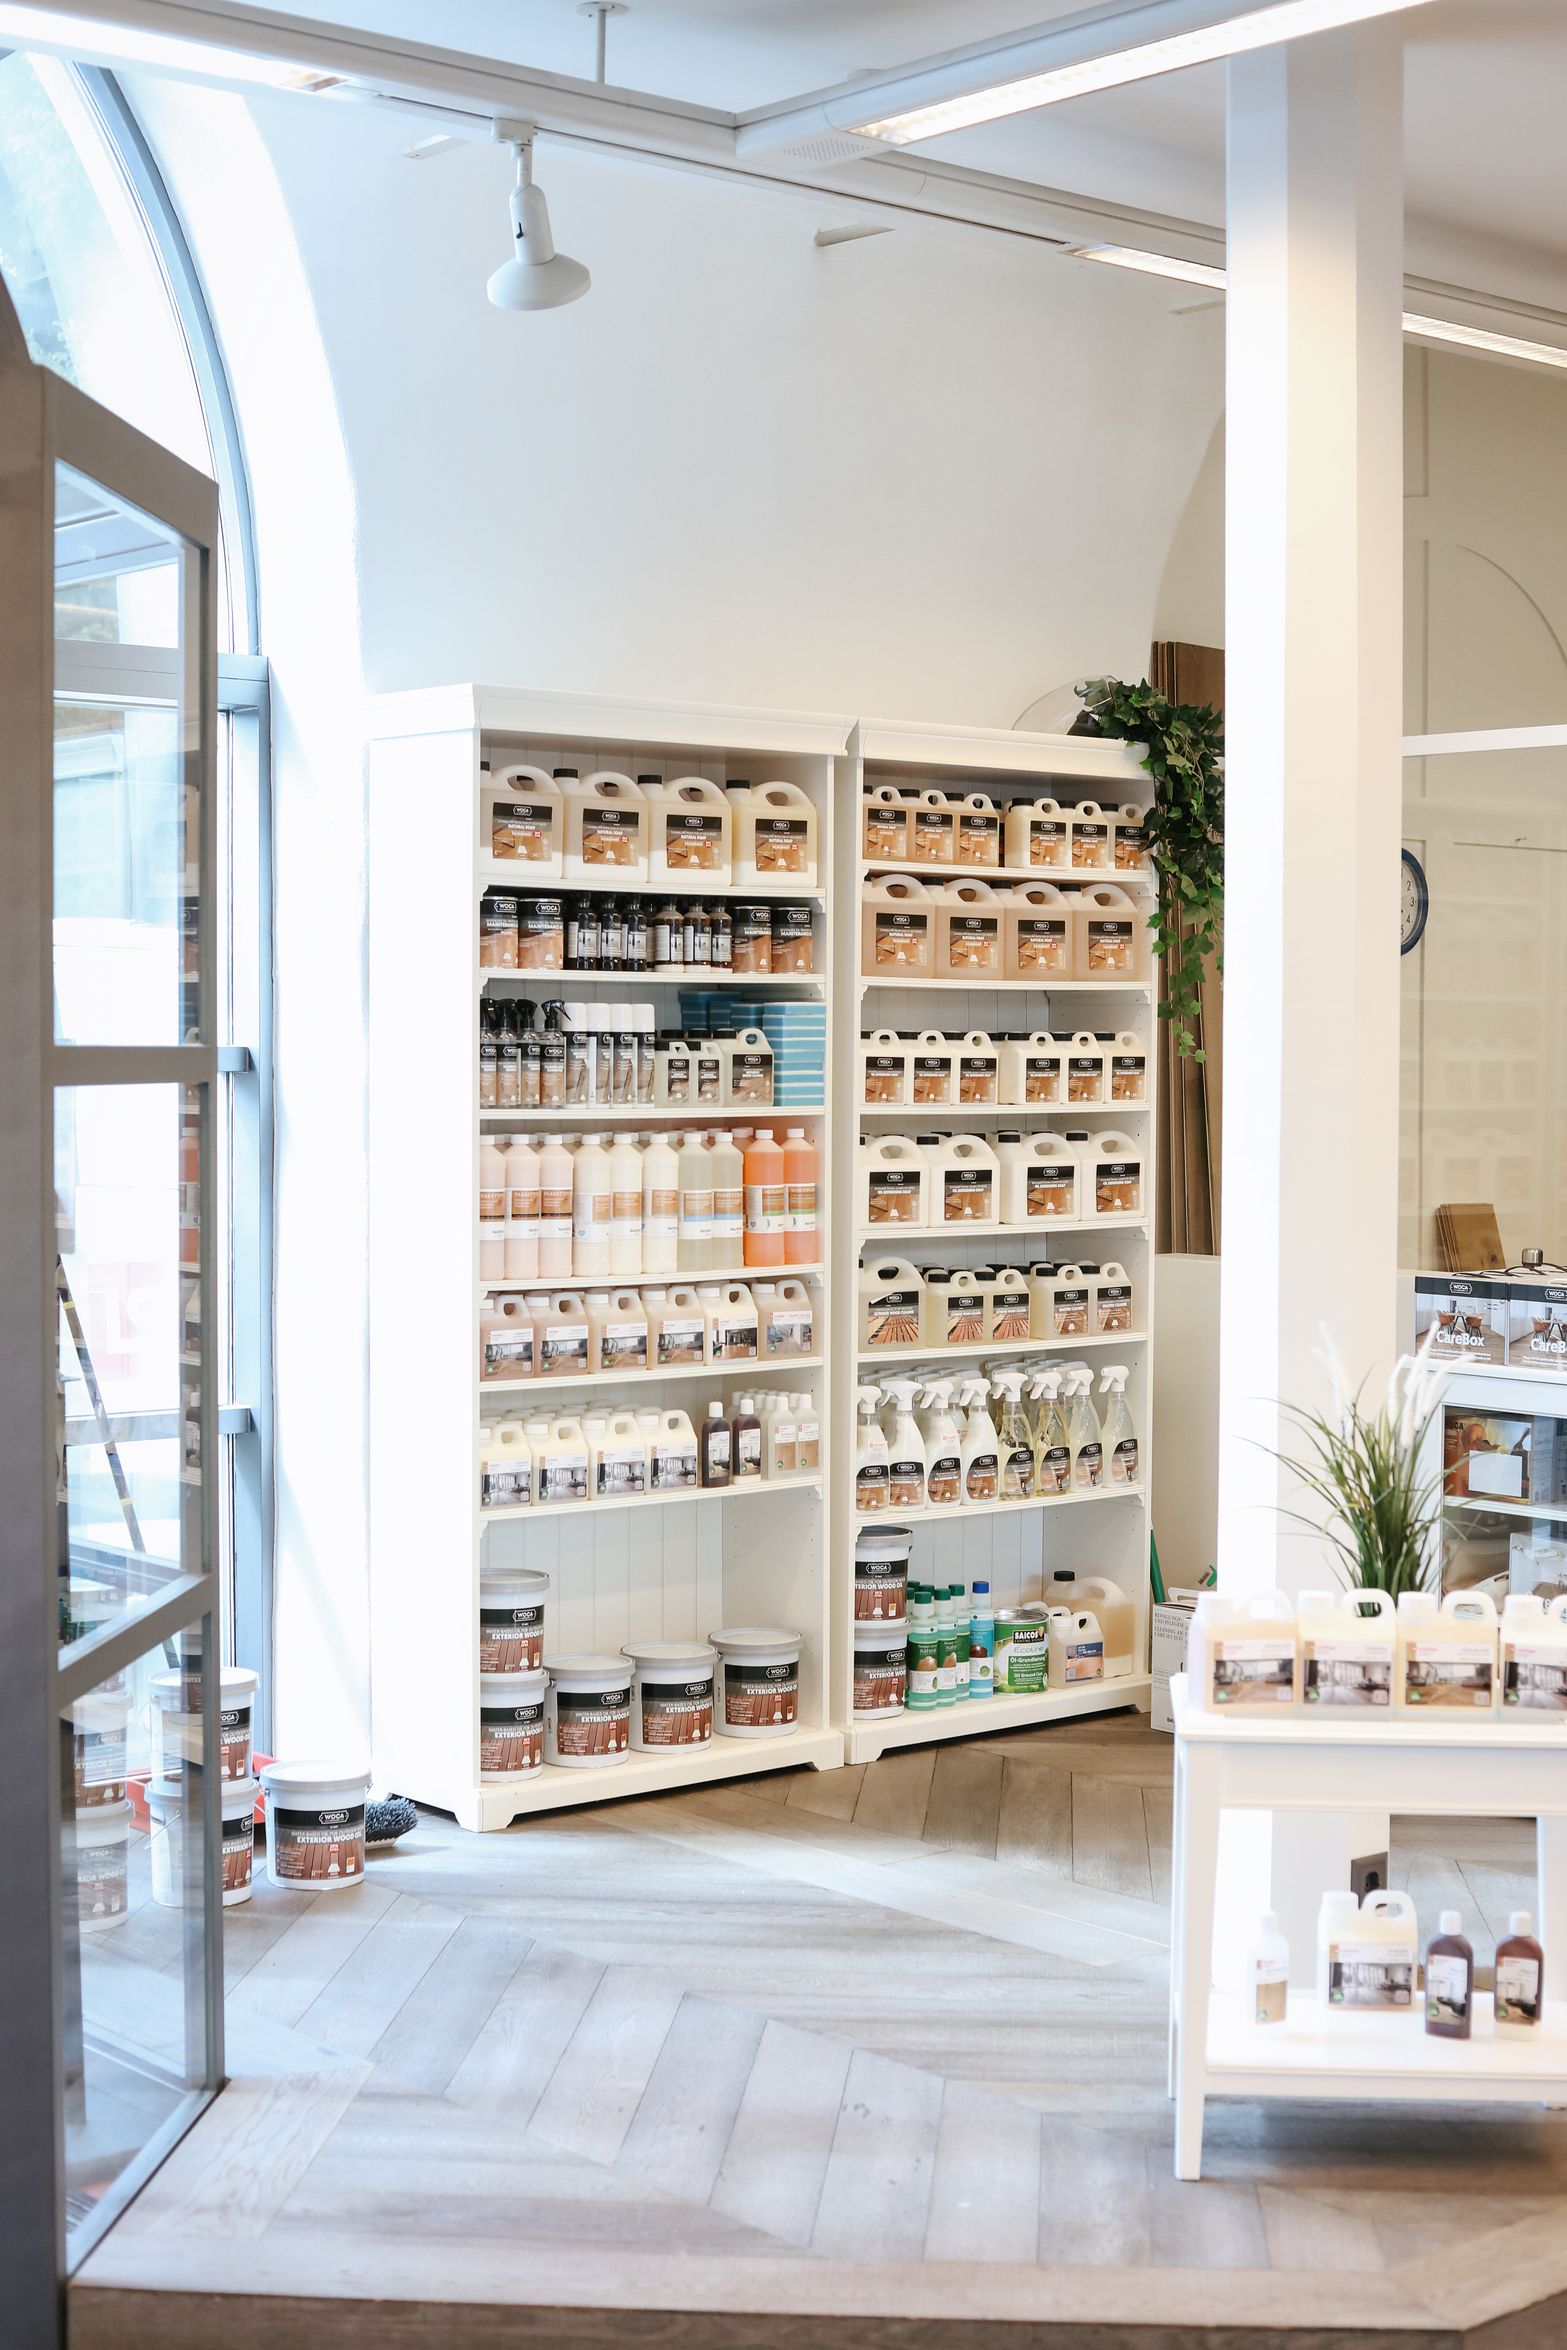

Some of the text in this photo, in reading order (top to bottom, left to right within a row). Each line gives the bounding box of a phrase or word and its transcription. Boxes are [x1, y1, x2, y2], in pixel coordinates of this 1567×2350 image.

[1436, 1331, 1485, 1347] CareBox
[1015, 1631, 1038, 1639] SAICOS
[224, 1735, 244, 1744] WOOD
[333, 1834, 354, 1842] WOOD
